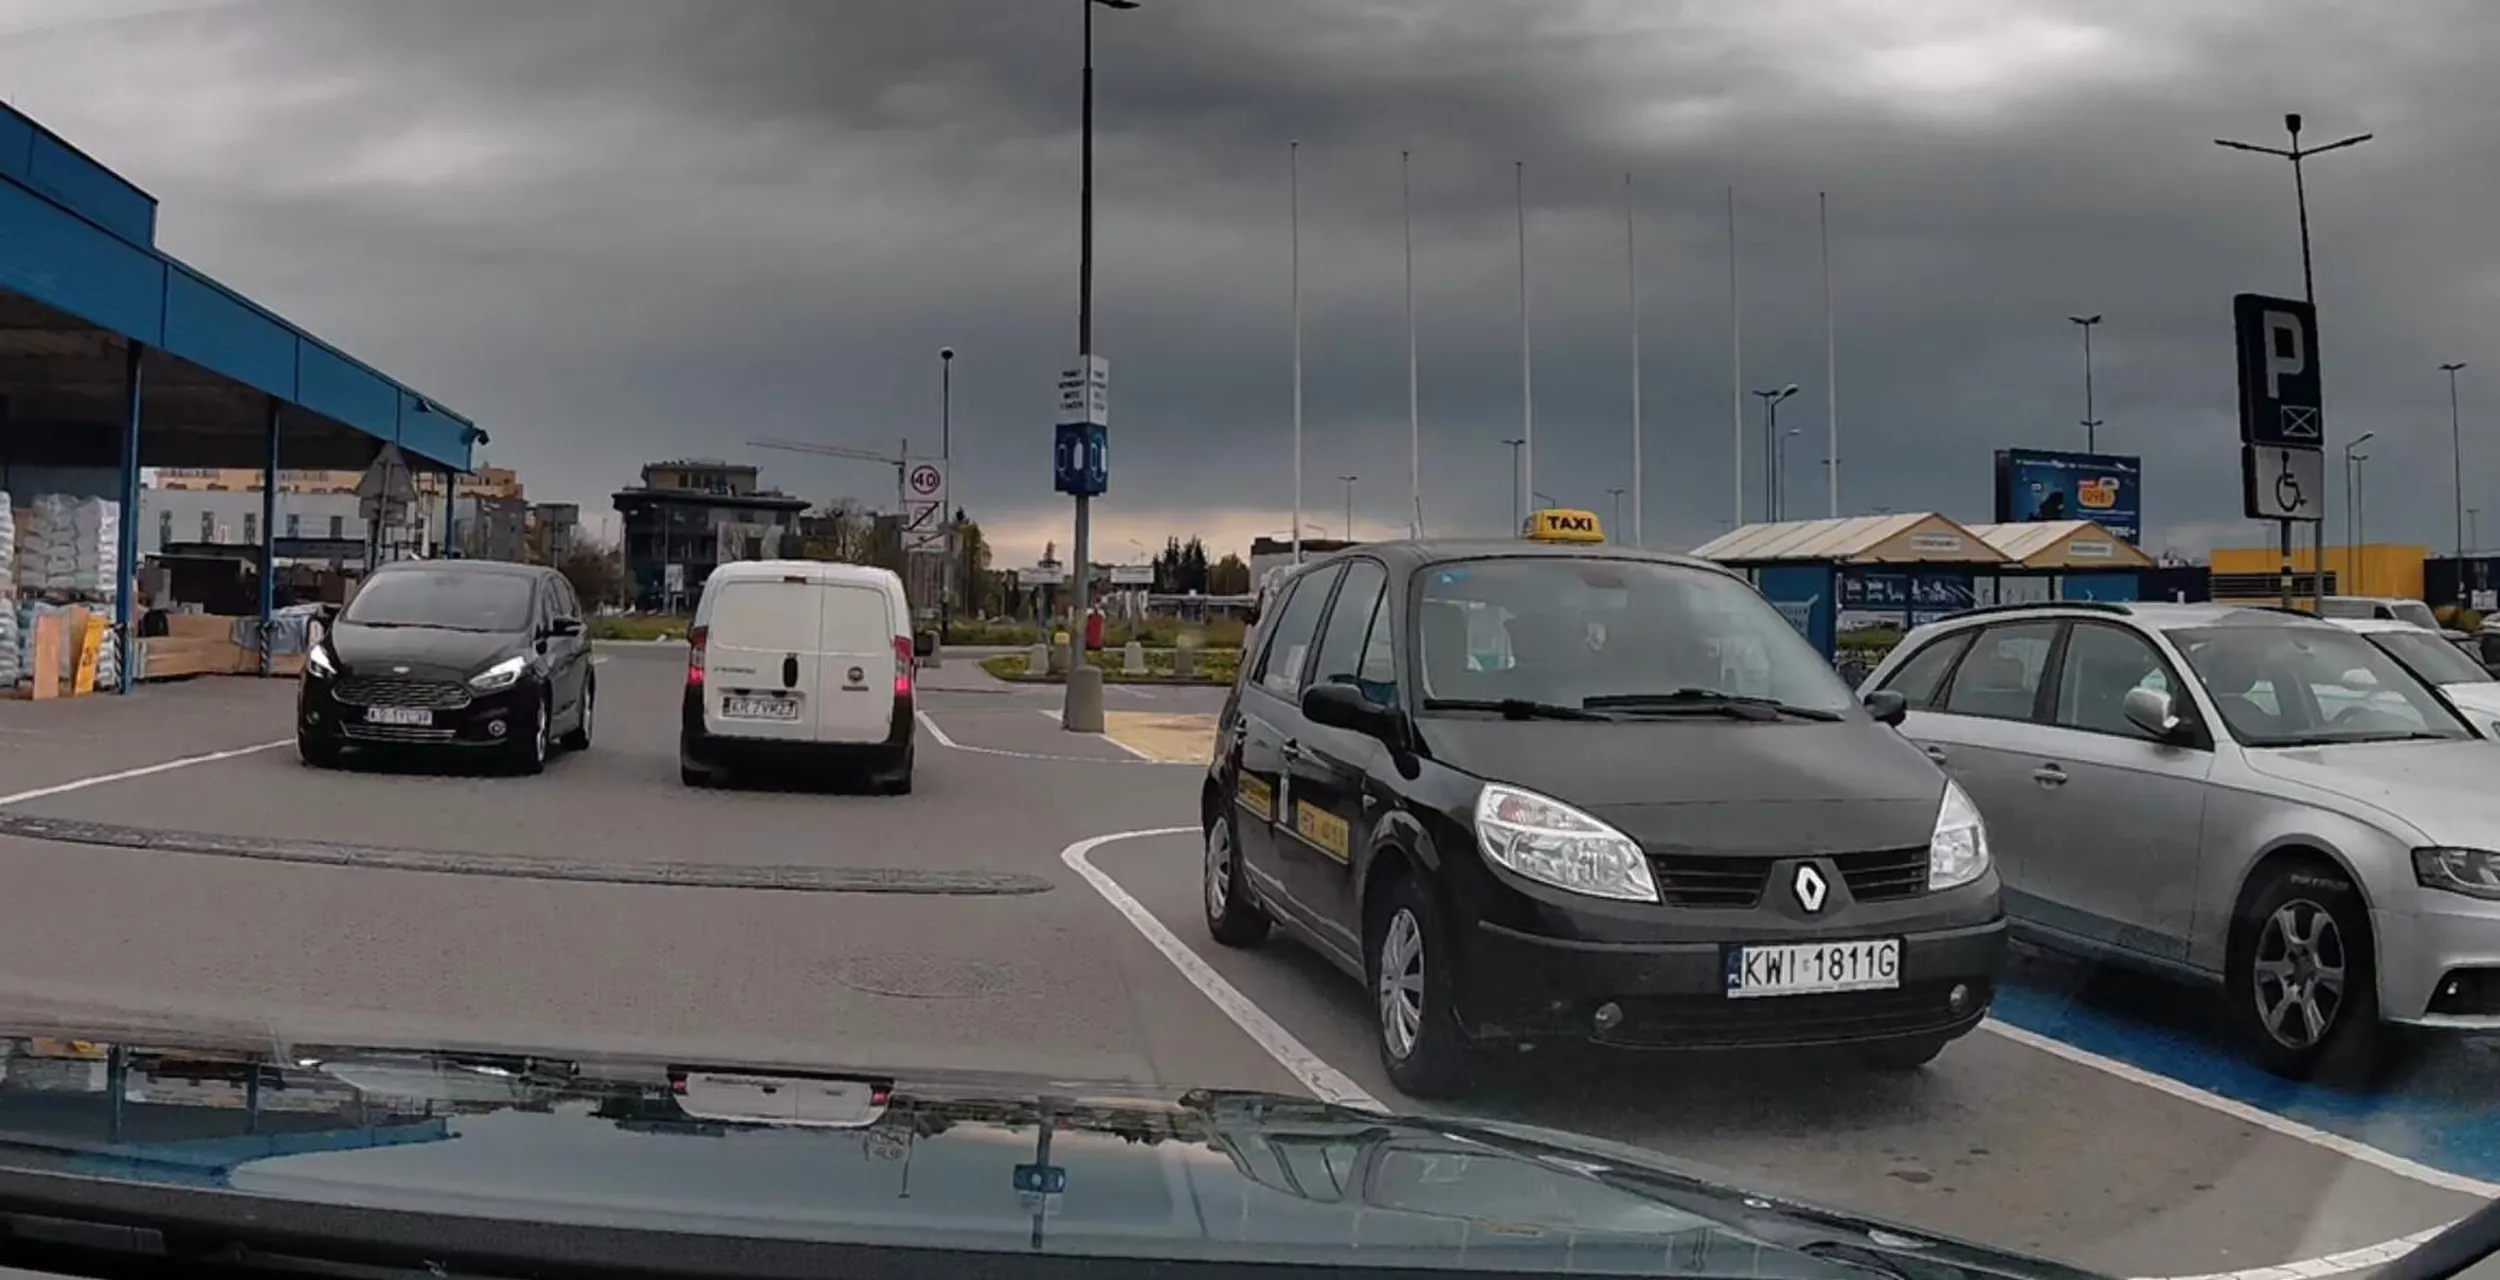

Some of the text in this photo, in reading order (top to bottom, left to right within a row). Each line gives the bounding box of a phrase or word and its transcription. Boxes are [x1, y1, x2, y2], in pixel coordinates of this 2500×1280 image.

[2262, 309, 2305, 400] P
[915, 472, 937, 488] 40
[1546, 515, 1593, 532] TAXI
[1745, 943, 1896, 987] KWI 1811G
